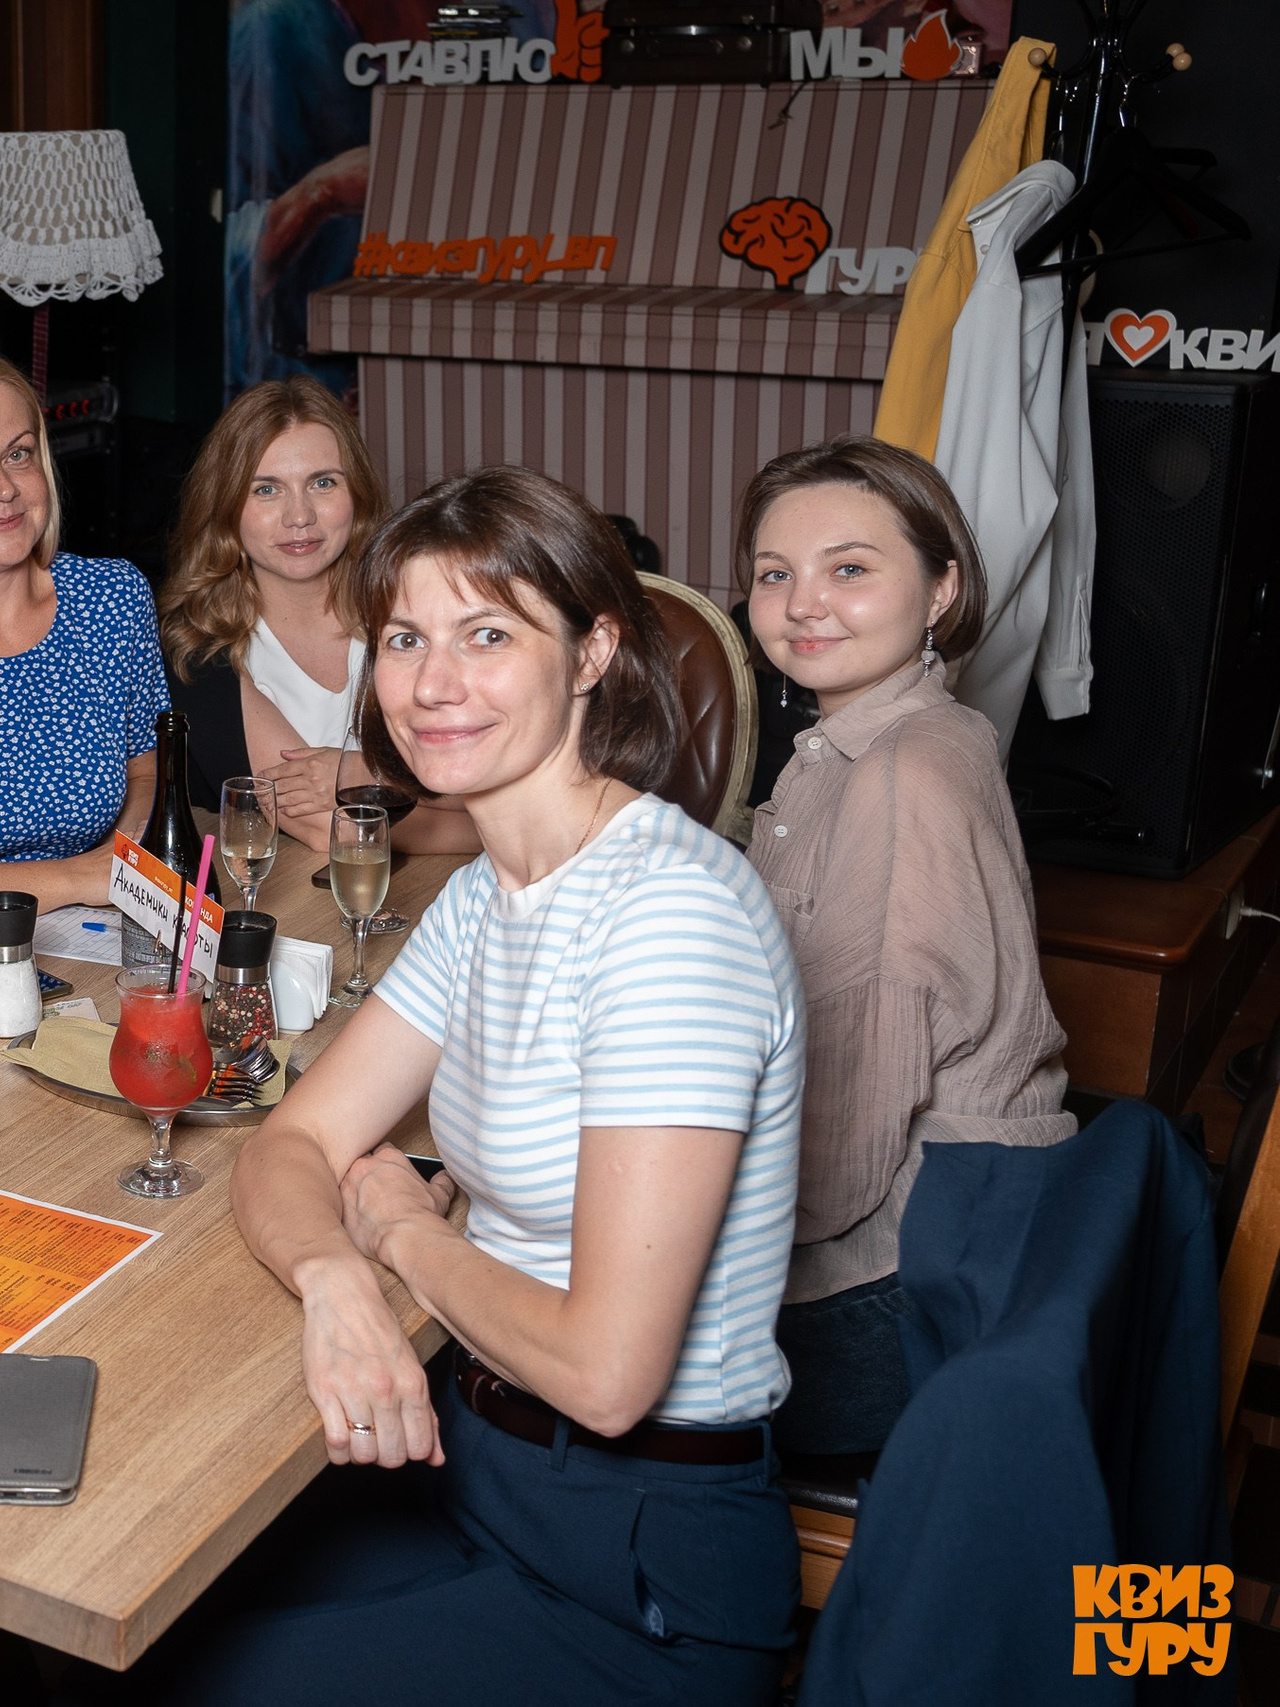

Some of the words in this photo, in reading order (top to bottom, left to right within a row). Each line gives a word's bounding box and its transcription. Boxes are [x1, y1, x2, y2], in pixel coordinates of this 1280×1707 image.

[343, 37, 556, 86] СТАВЛЮ
[789, 26, 905, 81] МЫ
[804, 246, 923, 296] ГУР
[185, 896, 213, 924] КОНДА
